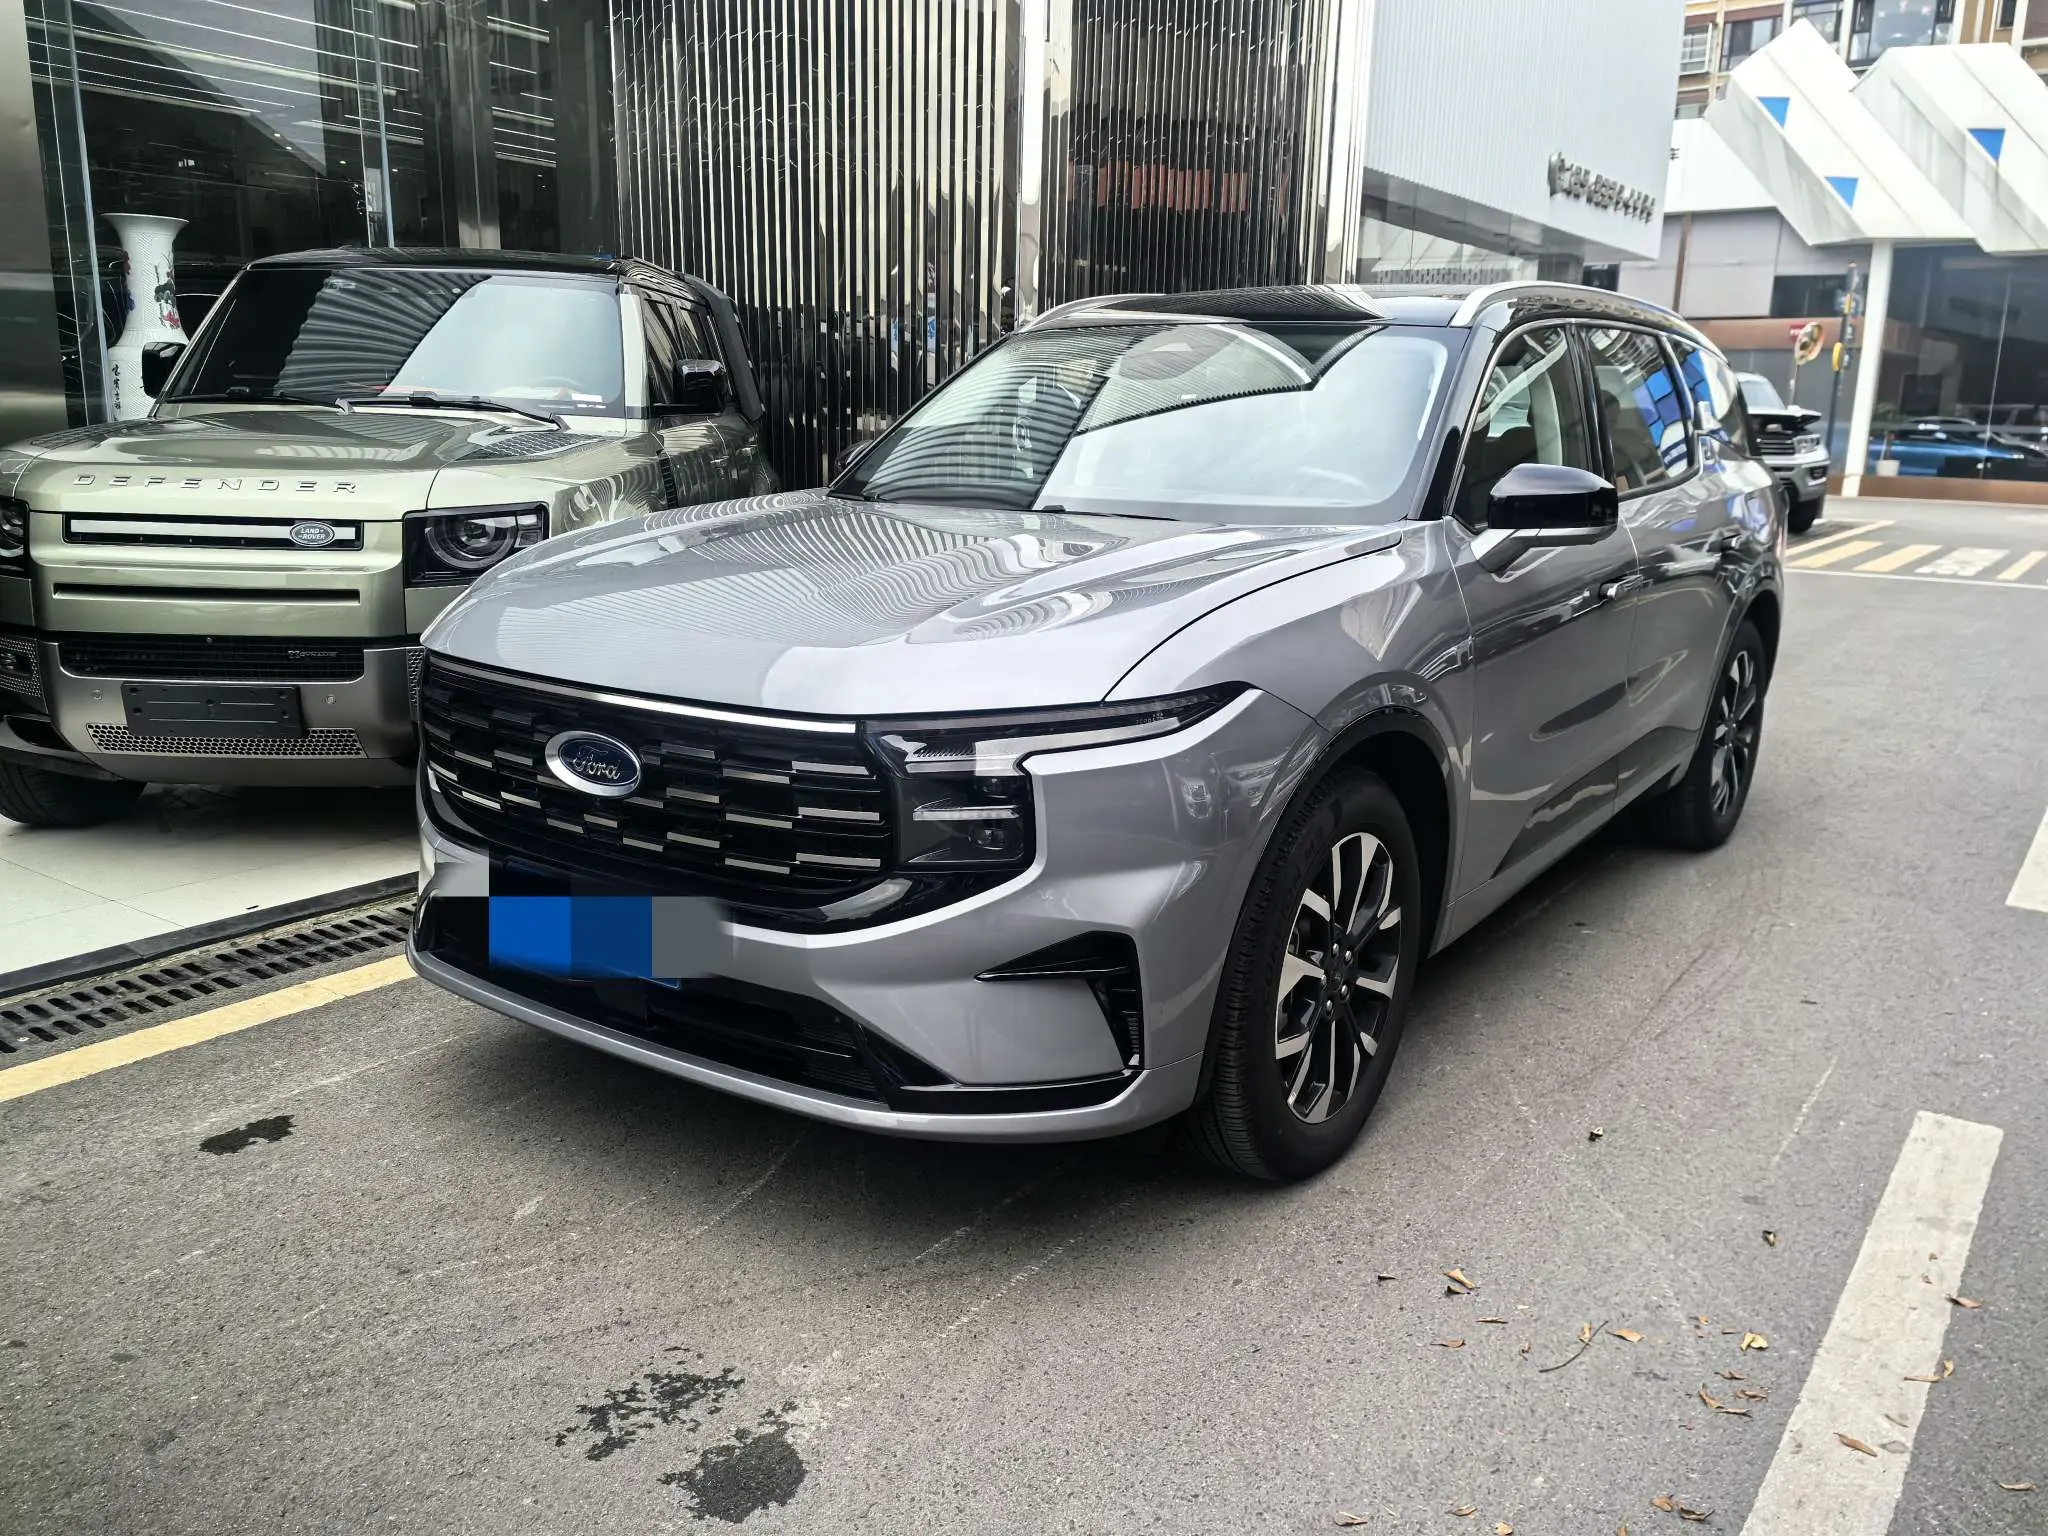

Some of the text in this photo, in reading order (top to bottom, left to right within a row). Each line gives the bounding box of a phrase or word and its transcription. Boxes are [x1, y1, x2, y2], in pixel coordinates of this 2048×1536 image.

[72, 473, 359, 493] DEFENDER
[300, 526, 321, 534] LAND
[572, 745, 621, 780] Ford
